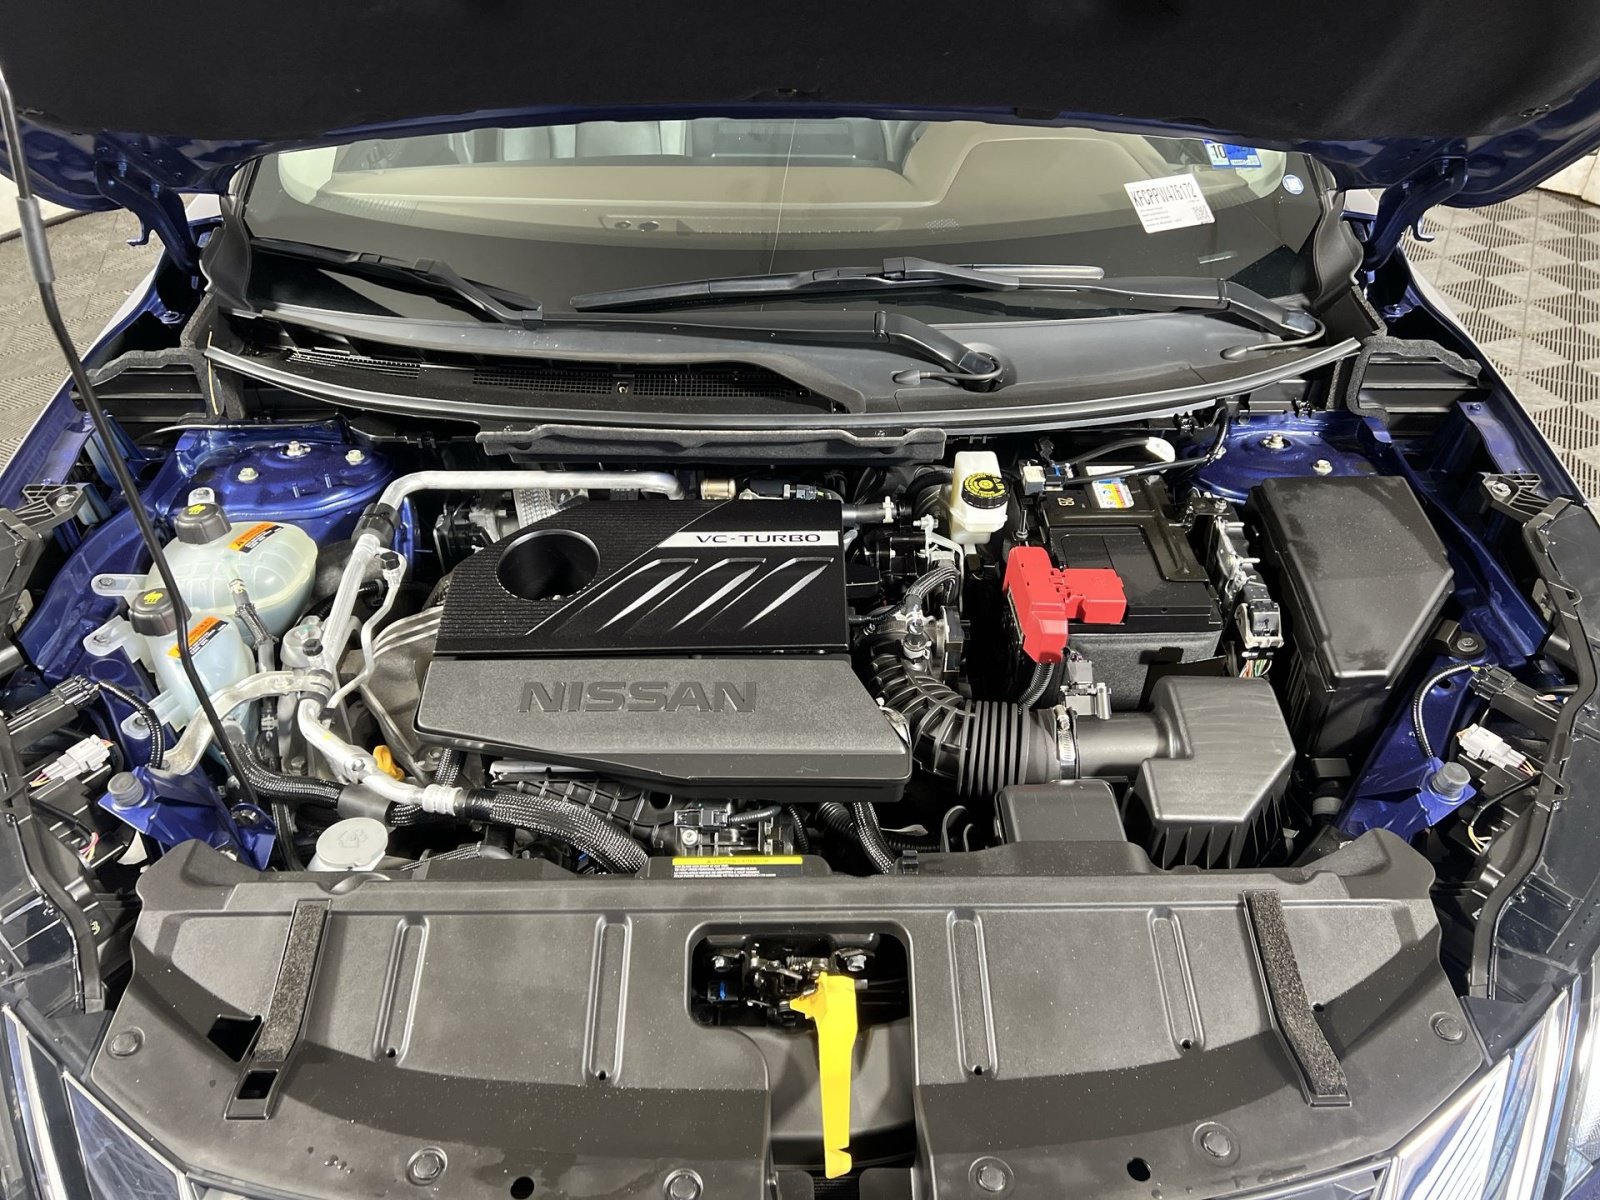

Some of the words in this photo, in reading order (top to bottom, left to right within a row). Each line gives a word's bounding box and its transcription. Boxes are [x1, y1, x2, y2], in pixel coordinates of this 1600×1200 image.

[1210, 144, 1227, 159] 10
[696, 533, 821, 544] VC-TURBO
[517, 681, 757, 713] NISSAN
